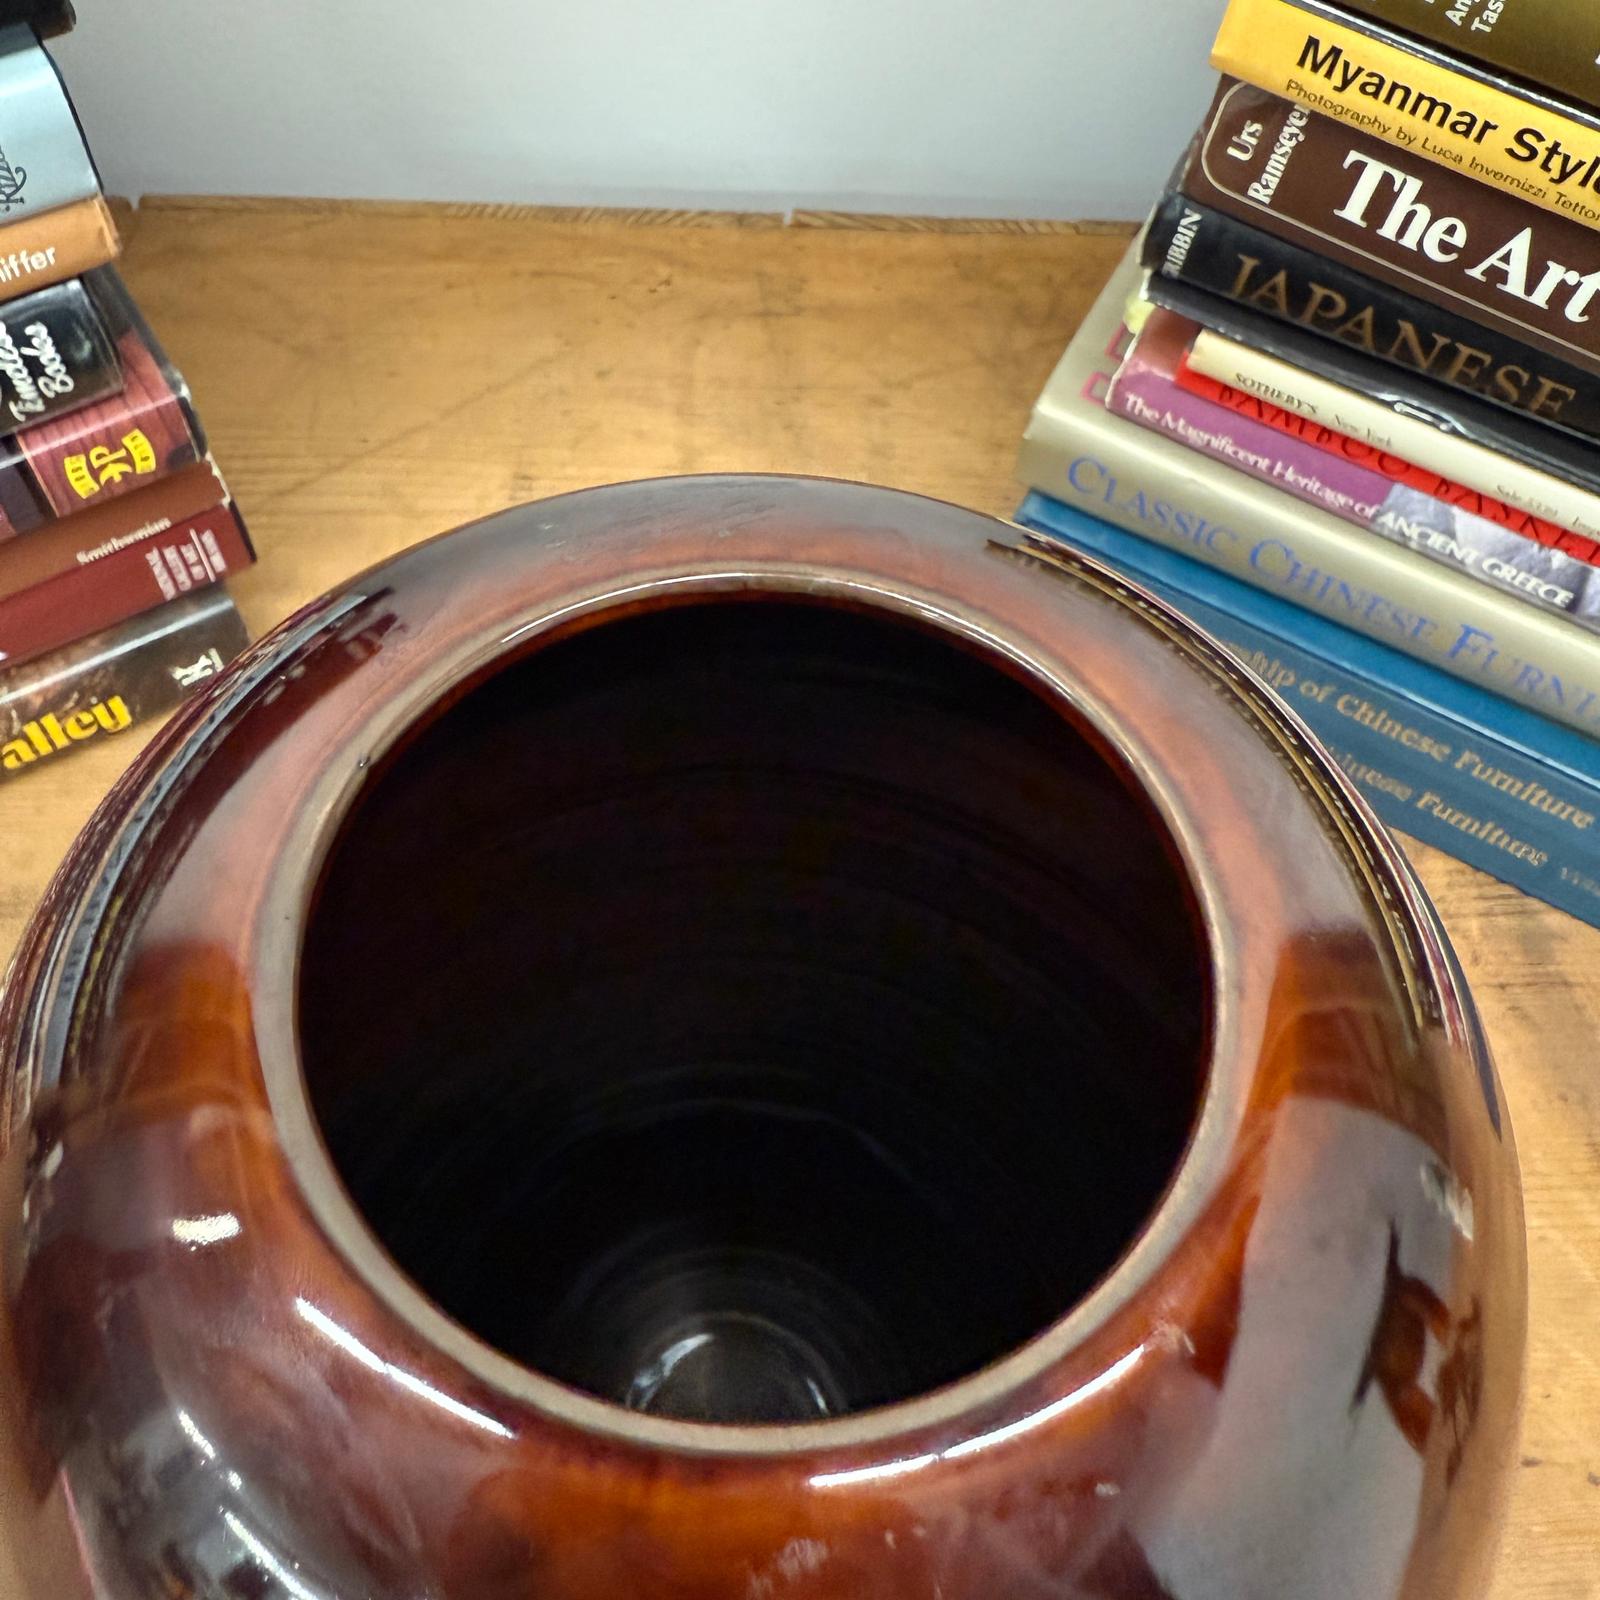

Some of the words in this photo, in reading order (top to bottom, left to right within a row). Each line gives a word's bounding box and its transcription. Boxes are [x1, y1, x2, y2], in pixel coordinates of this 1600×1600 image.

[1226, 120, 1263, 162] Urs
[1286, 78, 1391, 134] Photography
[1396, 127, 1417, 148] by
[1422, 137, 1463, 165] Luca
[1296, 35, 1498, 145] Myanmar
[1333, 150, 1467, 262] The
[1464, 227, 1600, 323] Art
[1226, 253, 1577, 420] JAPANESE
[1068, 455, 1238, 550] CLASSIC
[1249, 538, 1440, 640] CHINESE
[1124, 391, 1160, 421] The
[1162, 411, 1271, 473] Magnificent
[1272, 460, 1354, 507] Heritage
[1354, 499, 1382, 520] of
[1377, 511, 1480, 564] ANCIENT
[1482, 557, 1575, 608] GREECE
[1, 696, 132, 769] alley
[1300, 680, 1337, 703] of
[1336, 693, 1452, 762] Chinese
[1455, 748, 1595, 830] Furniture
[1417, 791, 1549, 867] Furniture
